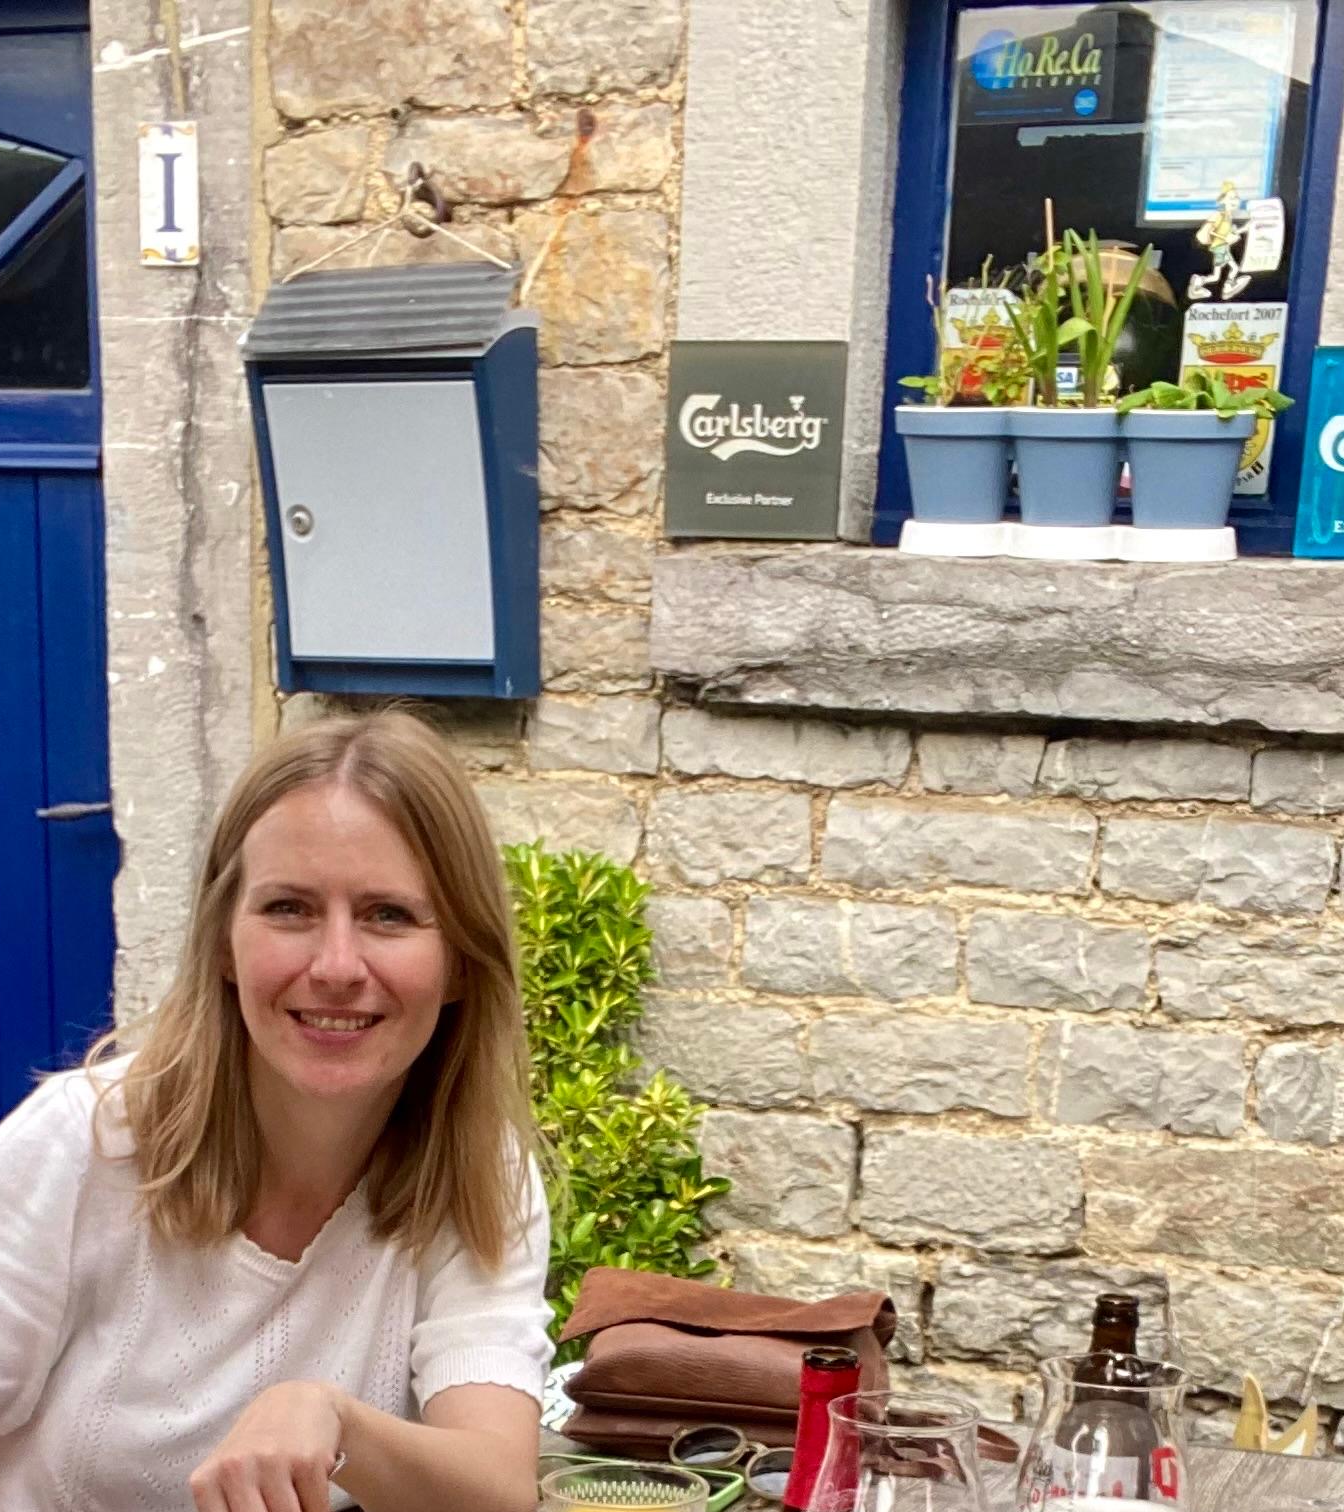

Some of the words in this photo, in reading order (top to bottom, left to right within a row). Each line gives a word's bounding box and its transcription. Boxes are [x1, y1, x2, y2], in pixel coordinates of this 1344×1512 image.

[1188, 307, 1250, 321] Rochefort
[1254, 306, 1283, 321] 2007
[679, 393, 829, 461] Carlsberg
